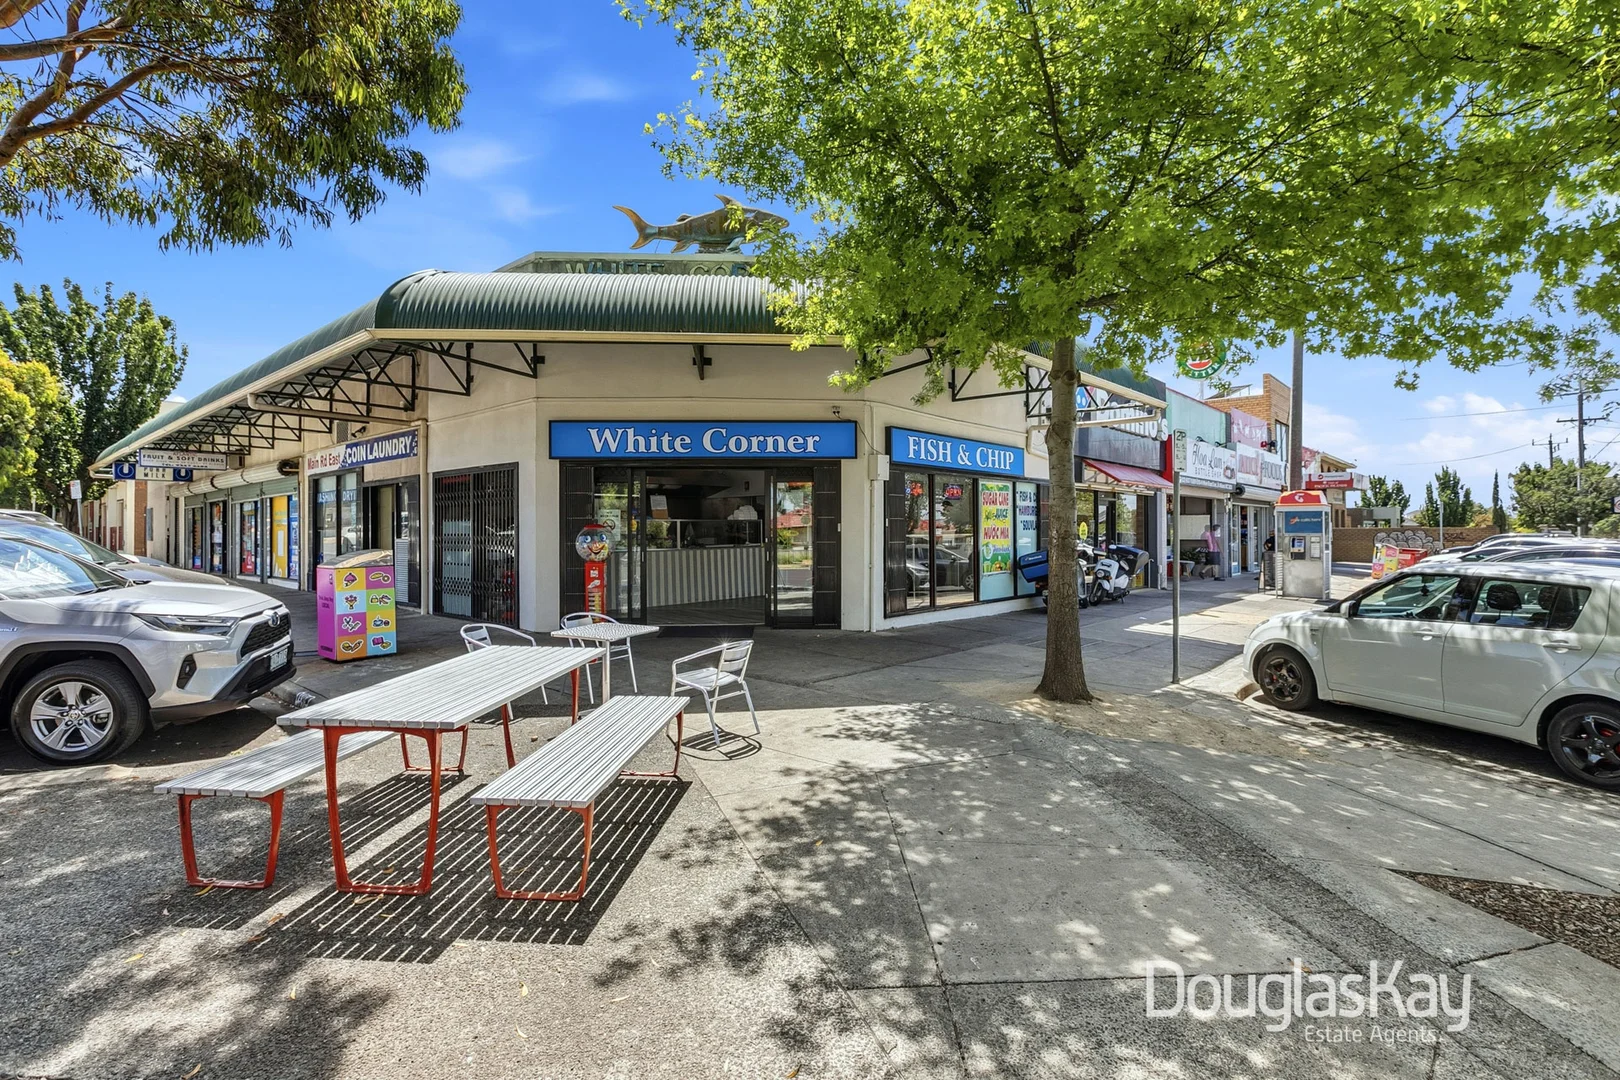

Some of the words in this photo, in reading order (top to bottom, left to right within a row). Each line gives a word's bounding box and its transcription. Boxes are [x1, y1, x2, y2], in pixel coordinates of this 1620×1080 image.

[586, 426, 692, 454] White
[701, 426, 821, 454] Corner
[1176, 431, 1187, 441] 2P
[346, 444, 366, 464] COIN
[367, 435, 412, 460] LAUNDRY
[907, 435, 952, 463] FISH
[957, 443, 972, 466] &
[975, 446, 1015, 471] CHIP
[307, 457, 320, 470] Main
[320, 455, 328, 468] Rd
[328, 451, 341, 466] East
[983, 491, 998, 506] SUGAR
[999, 493, 1009, 506] CANE
[1019, 491, 1029, 502] FISH
[995, 509, 1008, 519] JUICE
[1022, 520, 1036, 531] SOUVL
